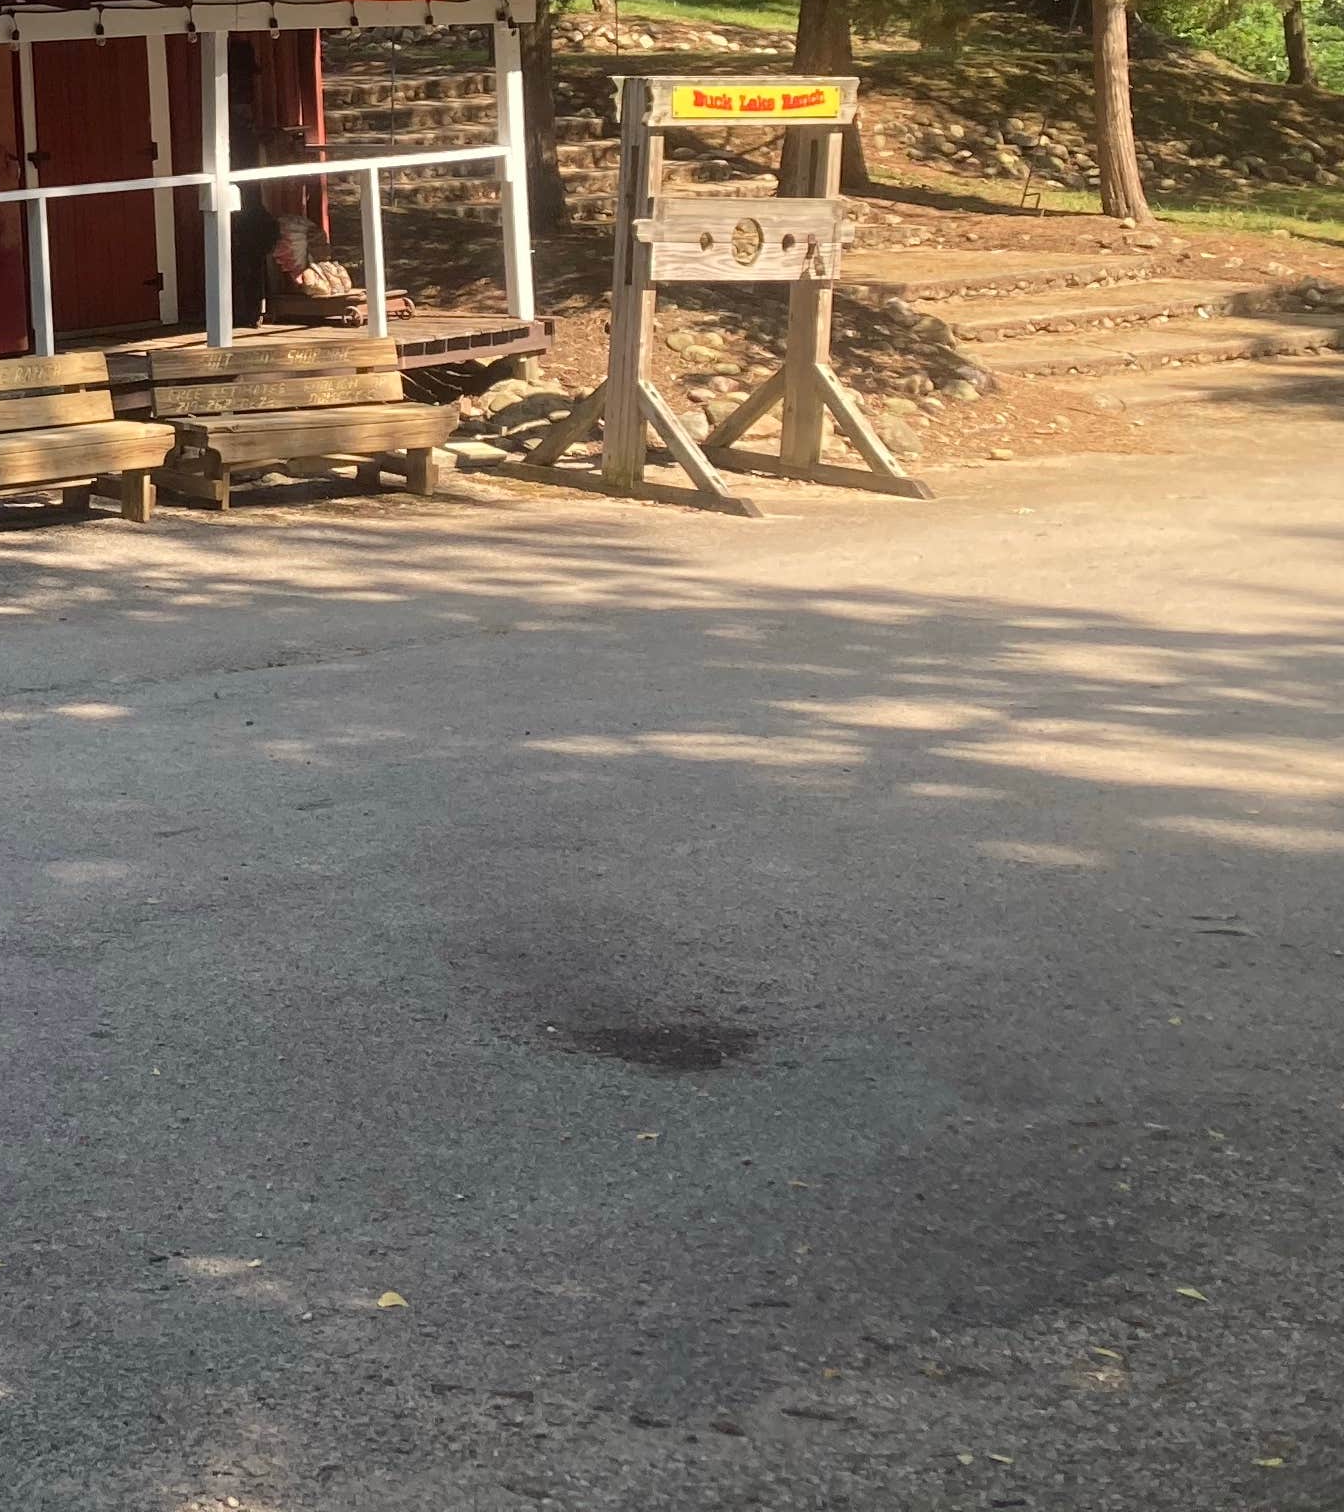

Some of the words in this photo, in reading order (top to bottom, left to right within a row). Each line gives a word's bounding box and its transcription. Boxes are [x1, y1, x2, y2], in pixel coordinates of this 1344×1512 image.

[691, 90, 731, 111] Buck
[738, 95, 774, 112] Lake
[780, 89, 824, 110] Ranch
